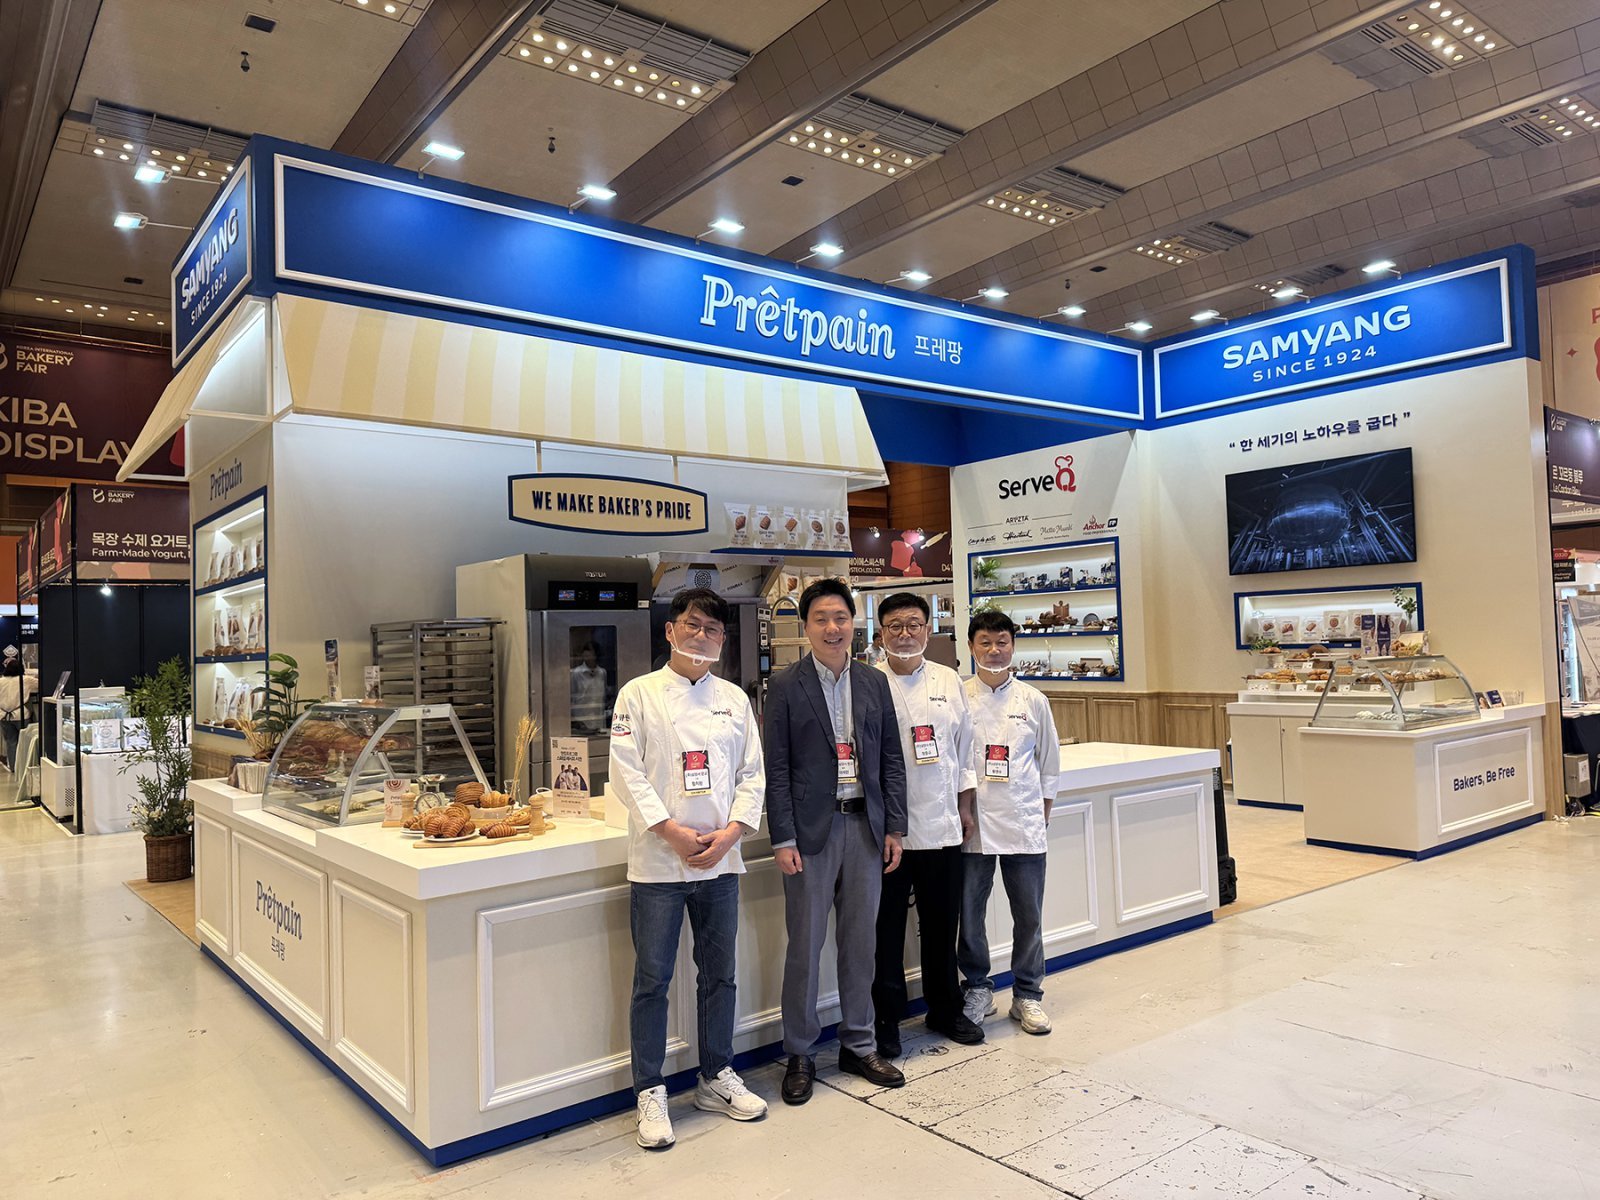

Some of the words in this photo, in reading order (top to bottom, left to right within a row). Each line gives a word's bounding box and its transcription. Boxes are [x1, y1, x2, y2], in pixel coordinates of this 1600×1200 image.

[182, 208, 238, 309] SAMYANG
[191, 290, 210, 325] SINCE
[211, 267, 228, 300] 1924
[701, 275, 896, 360] Prêtpain
[915, 335, 963, 365] 프레팡
[1223, 305, 1411, 369] SAMYANG
[16, 350, 74, 366] BAKERY
[16, 362, 48, 374] FAIR
[1253, 358, 1316, 382] SINCE
[1324, 345, 1377, 367] 1924
[1257, 431, 1297, 449] 세기의
[1302, 420, 1361, 441] 노하우를
[210, 457, 242, 501] Prêtpain
[1552, 464, 1558, 480] 르
[532, 490, 552, 510] WE
[557, 492, 594, 513] MAKE
[599, 496, 653, 518] BAKER'S
[657, 500, 691, 520] PRIDE
[92, 532, 119, 546] 목장
[121, 533, 147, 547] 수제
[1083, 523, 1105, 531] Anchor
[92, 548, 150, 557] Farm-Made
[151, 549, 186, 559] Yogurt,
[1453, 775, 1485, 791] Bakers,
[1486, 770, 1497, 783] Be
[1498, 766, 1515, 780] Free
[256, 880, 303, 941] Prêtpain
[271, 935, 286, 961] 프레팡
